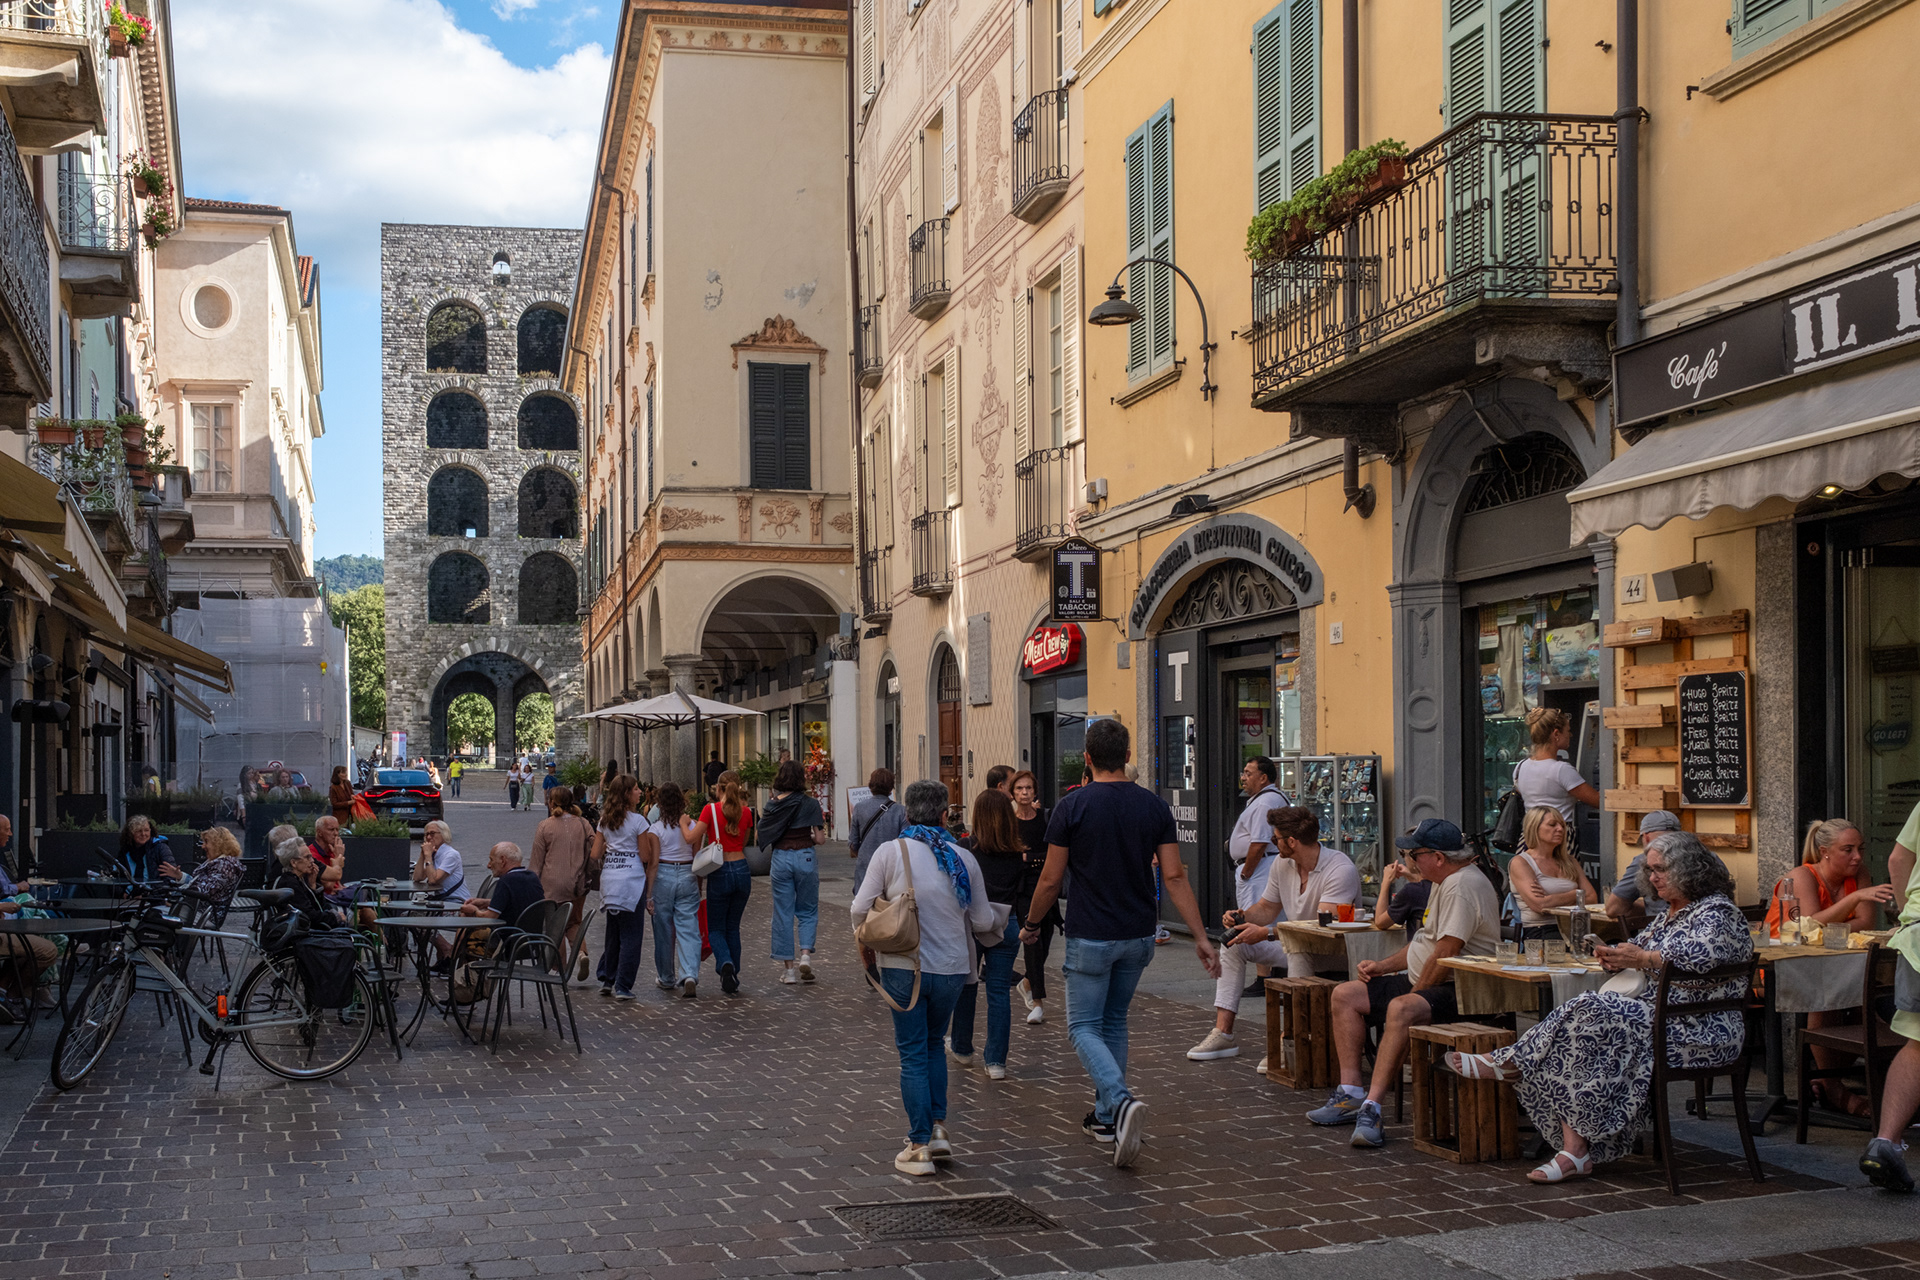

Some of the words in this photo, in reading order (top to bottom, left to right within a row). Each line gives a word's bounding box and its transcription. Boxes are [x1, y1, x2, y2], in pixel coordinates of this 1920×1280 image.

[1791, 292, 1857, 362] IL
[1066, 542, 1088, 551] Chicco
[1059, 553, 1094, 596] T
[1131, 540, 1192, 629] TABACCHERIA
[1193, 524, 1262, 555] RICEVITORIA
[1265, 537, 1313, 593] CHICCO
[1626, 579, 1640, 597] 44
[1058, 603, 1097, 611] TABACCHI
[1332, 626, 1341, 640] 46
[1024, 639, 1044, 666] MEAT
[1043, 631, 1061, 660] CREW
[1167, 650, 1190, 702] T
[1686, 688, 1707, 699] HUGO
[1873, 730, 1886, 742] GO
[1169, 805, 1197, 821] ACCHERIA
[1176, 821, 1198, 843] hicco
